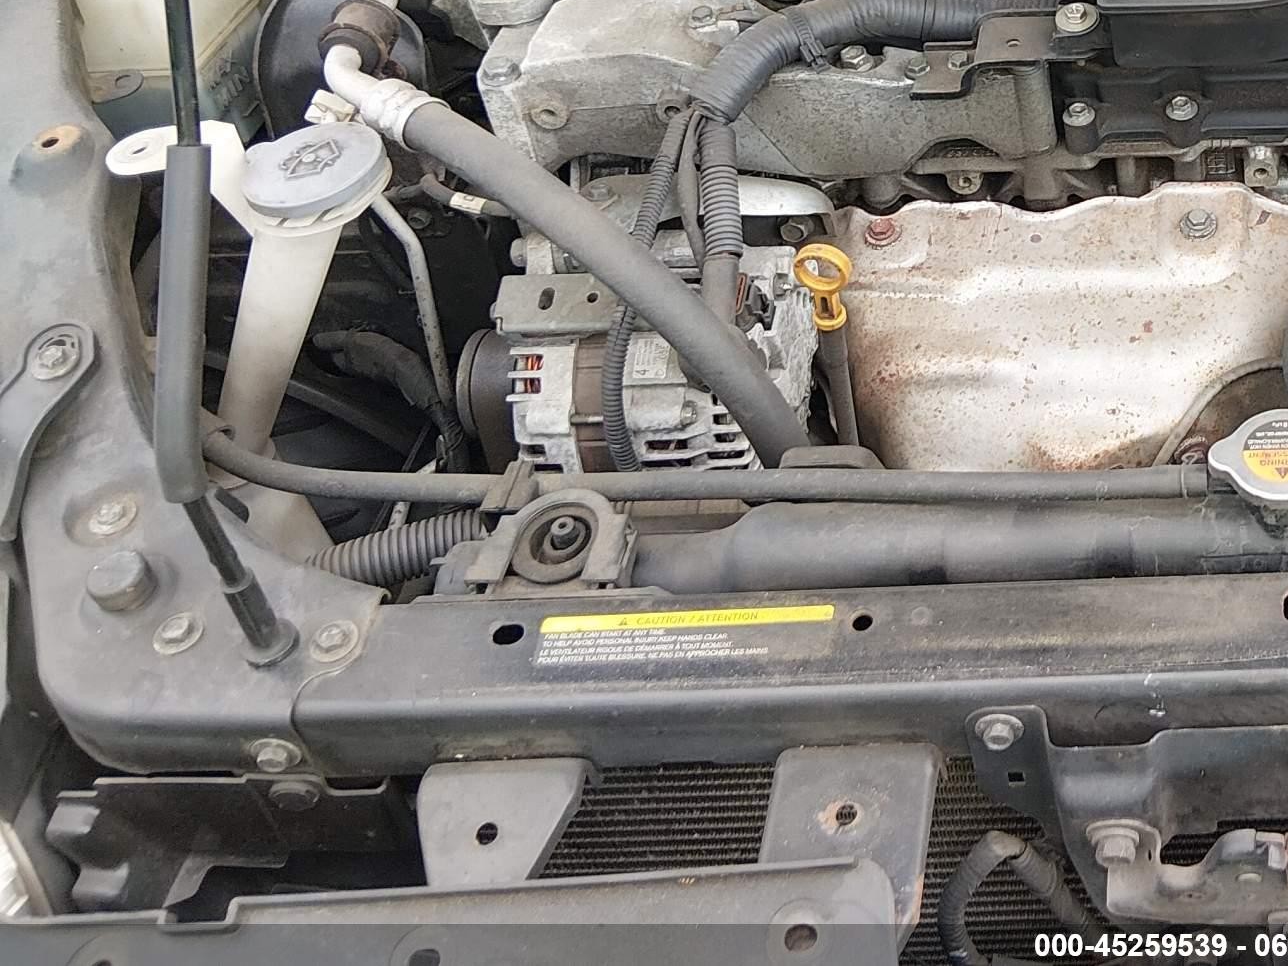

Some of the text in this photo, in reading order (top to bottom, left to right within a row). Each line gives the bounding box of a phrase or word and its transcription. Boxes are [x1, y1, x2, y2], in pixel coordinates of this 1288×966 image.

[637, 616, 685, 625] CAUTION
[696, 612, 759, 622] ATTENTION
[572, 638, 595, 646] AVOID
[678, 634, 703, 642] HANDS
